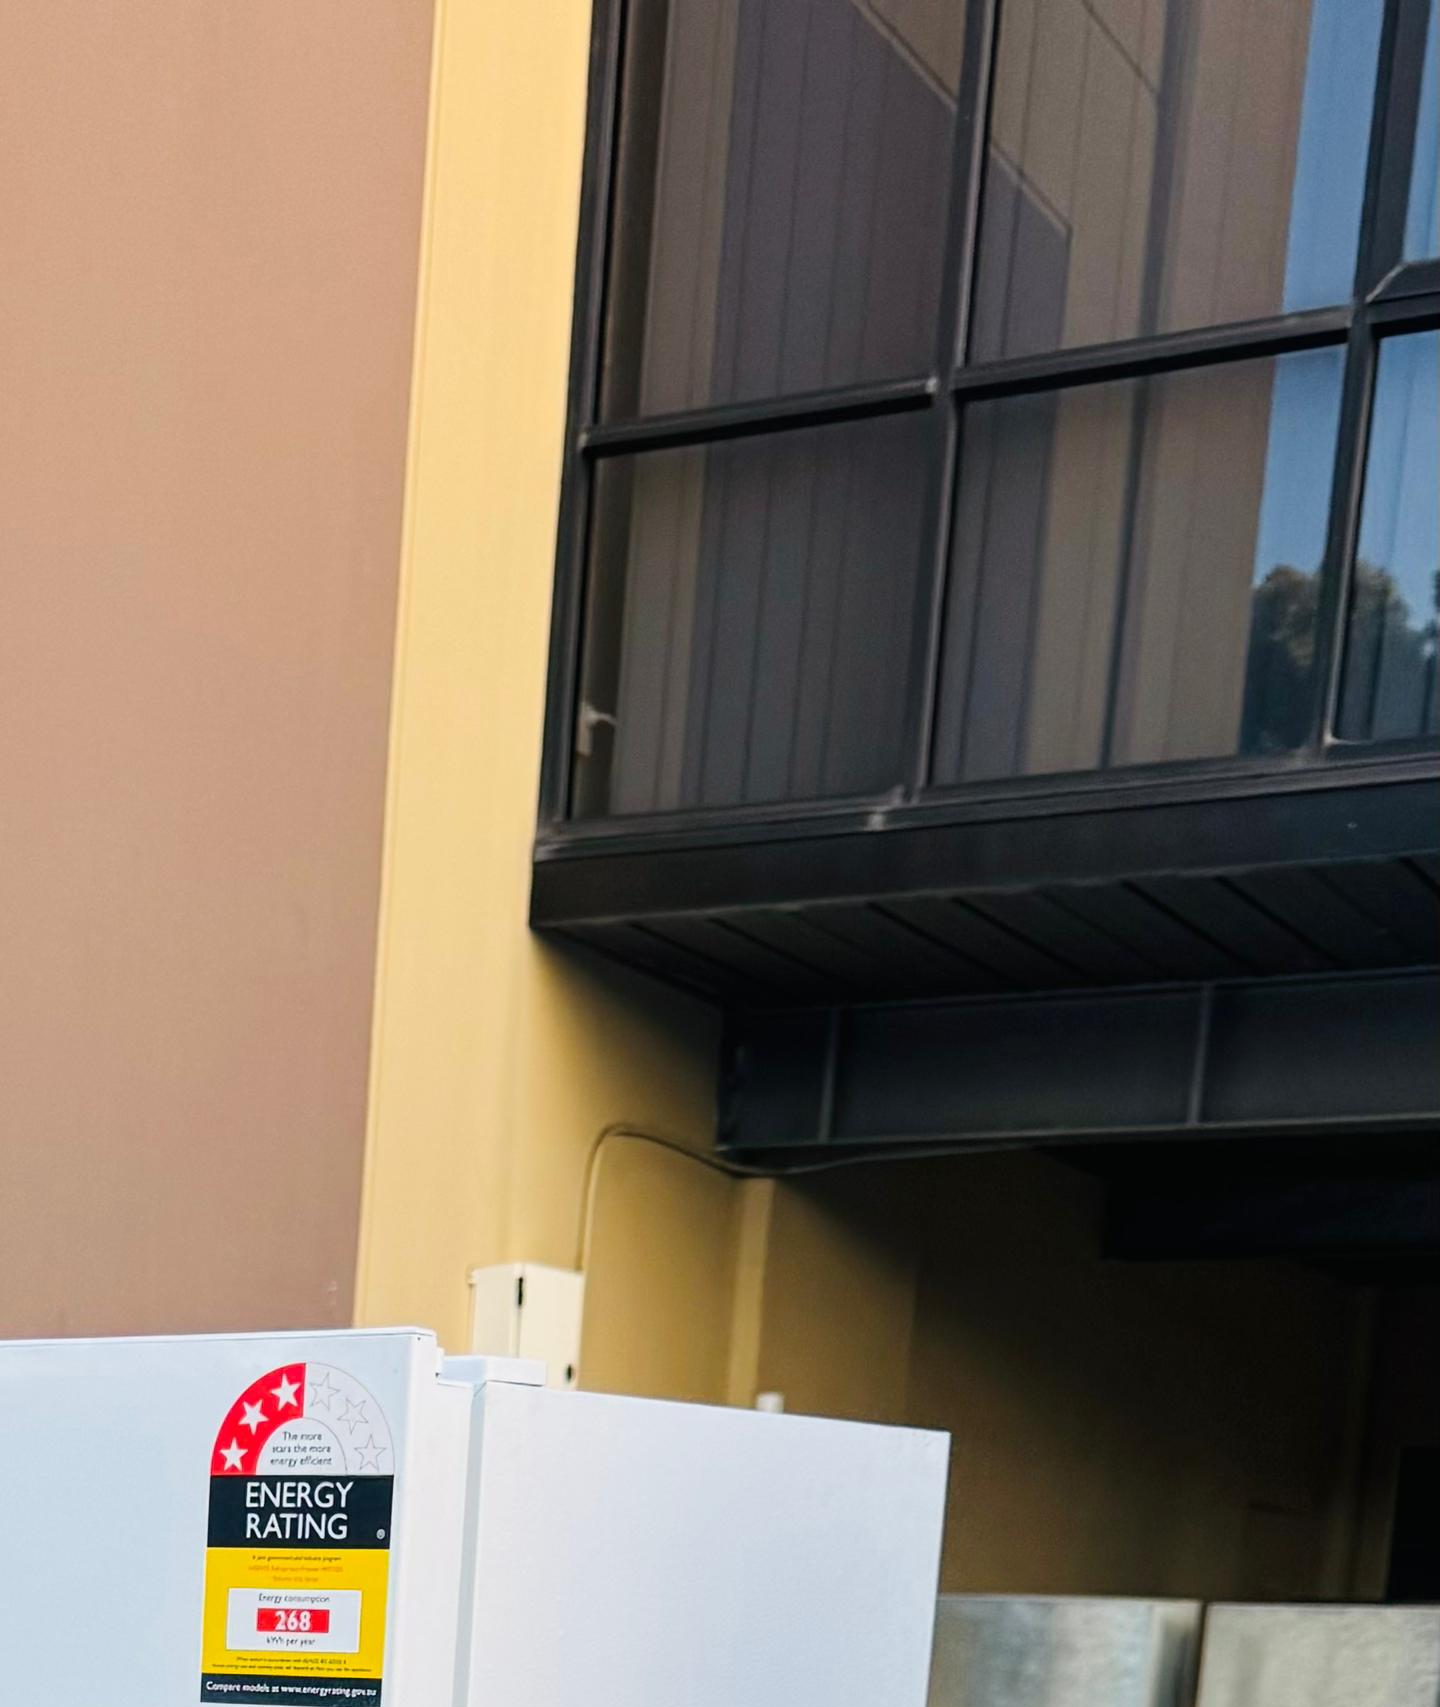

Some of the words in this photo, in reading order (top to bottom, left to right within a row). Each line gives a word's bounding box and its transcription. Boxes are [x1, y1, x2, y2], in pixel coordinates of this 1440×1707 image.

[245, 1481, 354, 1508] ENERGY
[245, 1513, 348, 1540] RATING
[275, 1610, 311, 1631] 268
[206, 1681, 241, 1693] Compare
